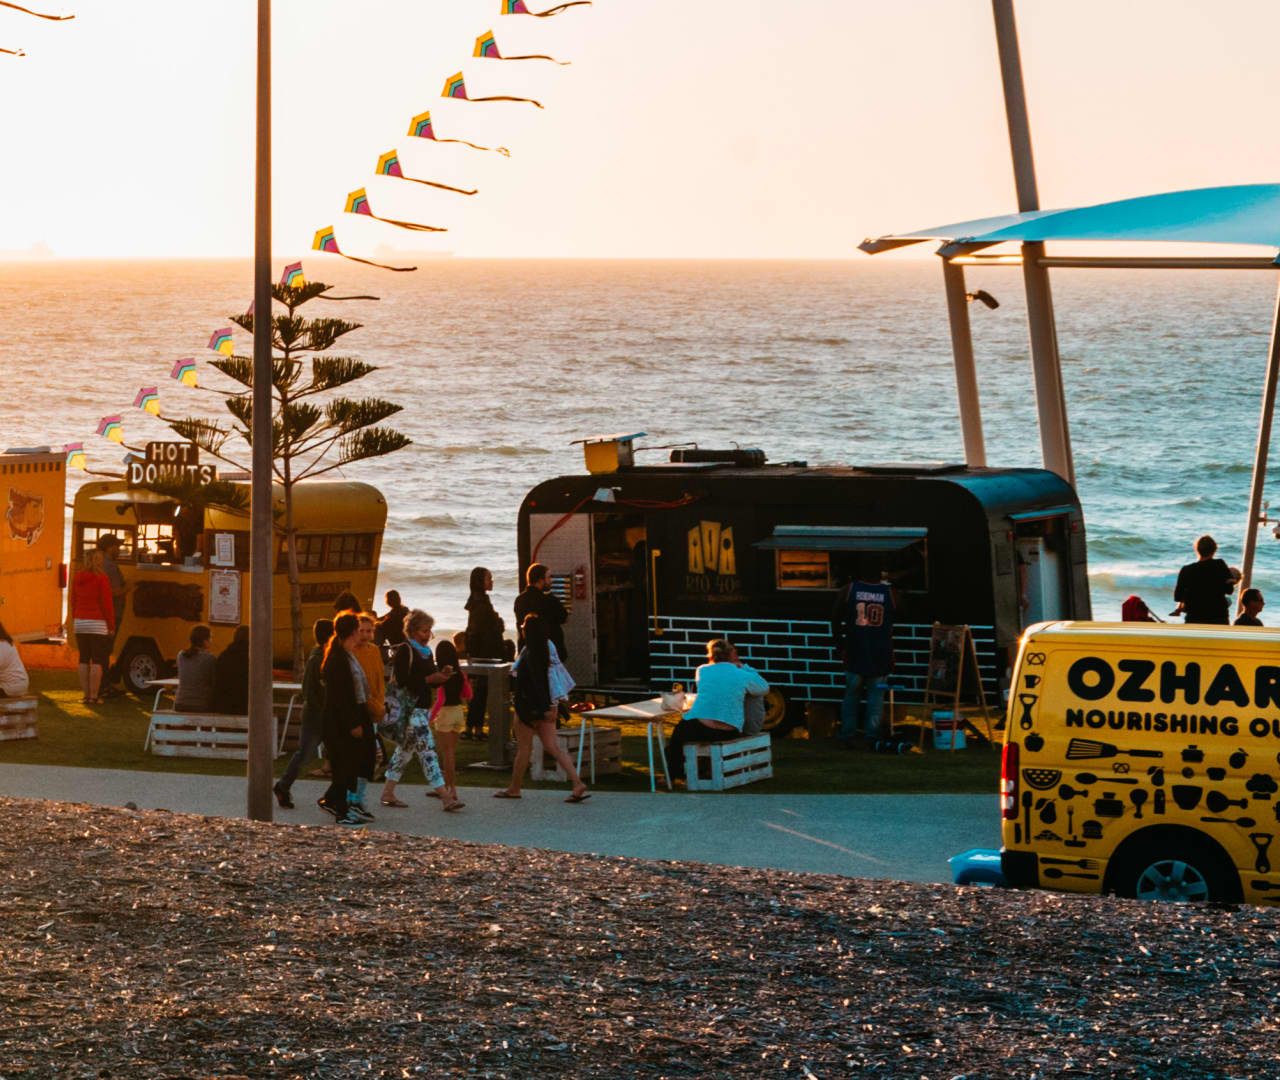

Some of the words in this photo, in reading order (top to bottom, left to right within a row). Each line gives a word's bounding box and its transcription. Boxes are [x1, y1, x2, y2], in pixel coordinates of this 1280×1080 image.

[152, 443, 192, 462] HOT
[131, 463, 212, 485] DONUTS
[855, 602, 884, 627] 10
[1067, 656, 1280, 710] OZHAR
[1066, 708, 1239, 736] NOURISHING
